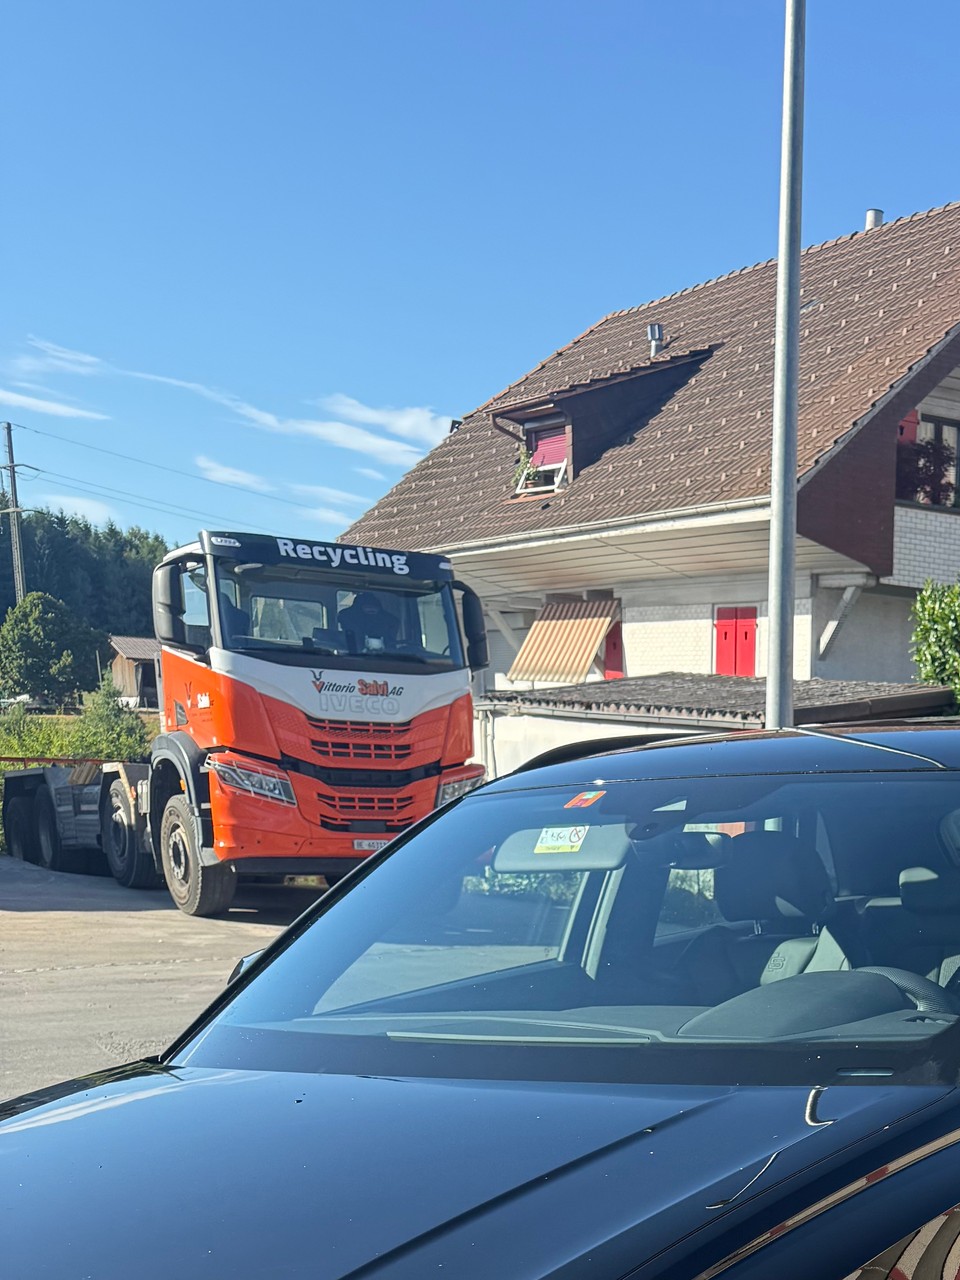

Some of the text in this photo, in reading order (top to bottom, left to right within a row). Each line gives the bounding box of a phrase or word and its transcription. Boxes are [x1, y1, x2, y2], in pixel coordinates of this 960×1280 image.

[276, 537, 410, 575] Recycling
[311, 678, 404, 697] Vittorio Salvi AG
[319, 694, 400, 715] IVECO
